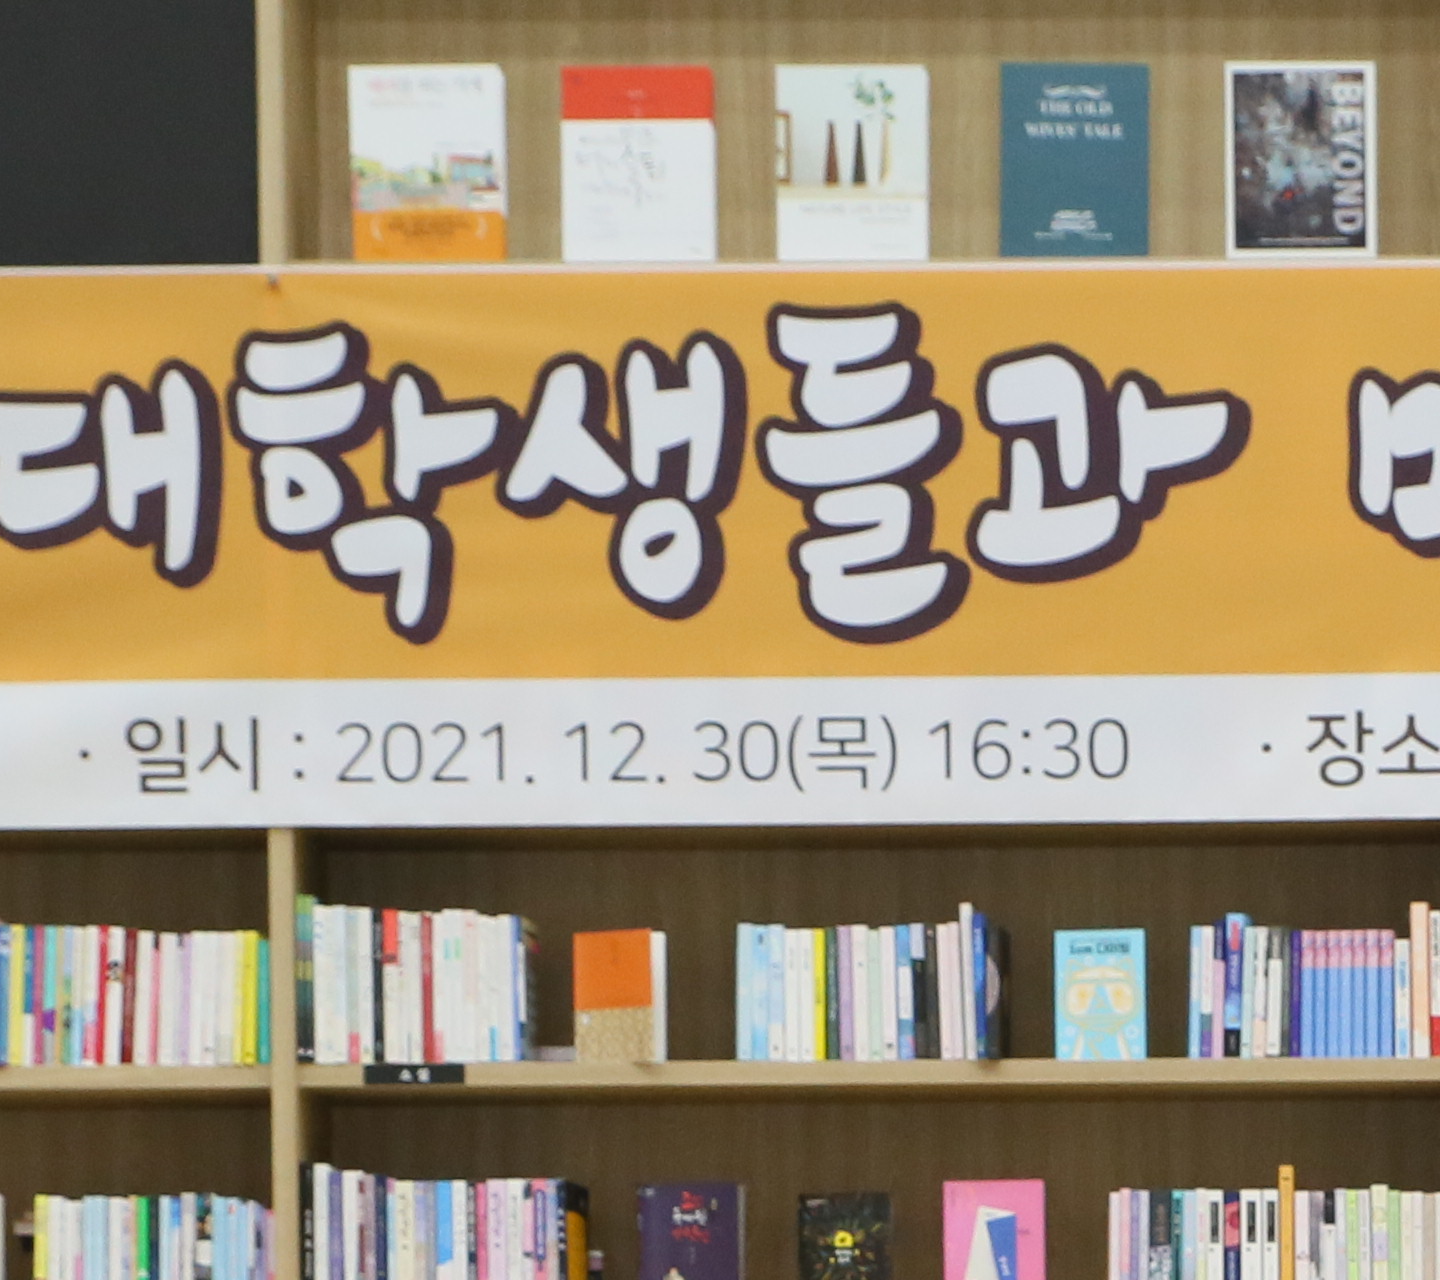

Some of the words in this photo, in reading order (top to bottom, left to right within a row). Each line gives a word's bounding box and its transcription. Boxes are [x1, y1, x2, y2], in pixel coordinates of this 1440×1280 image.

[1331, 81, 1364, 235] BEYOND
[124, 714, 263, 794] 일시
[334, 720, 537, 786] 2021.
[563, 720, 668, 786] 12.
[692, 713, 900, 790] 30(목)
[927, 716, 1131, 781] 16:30
